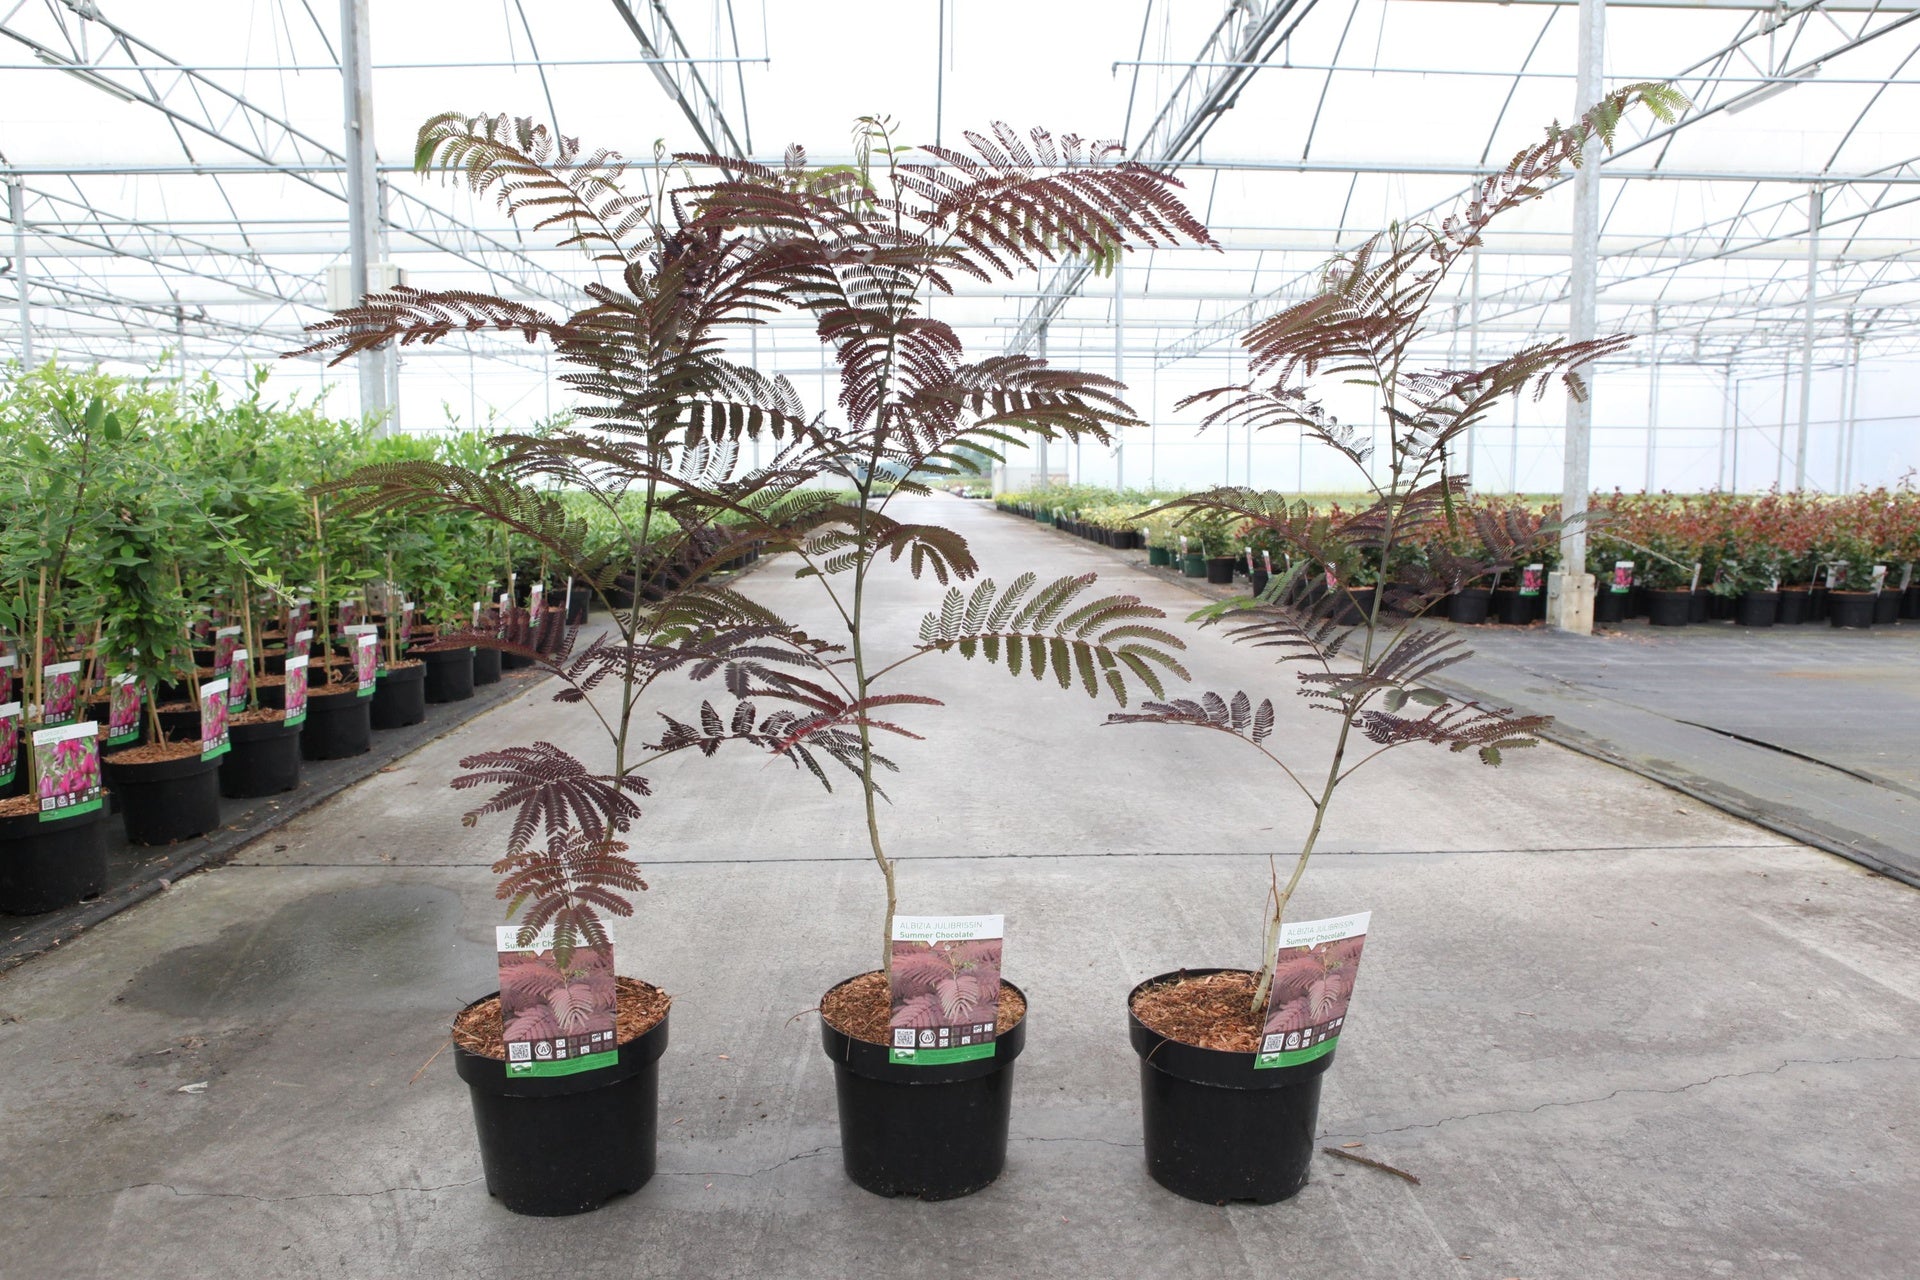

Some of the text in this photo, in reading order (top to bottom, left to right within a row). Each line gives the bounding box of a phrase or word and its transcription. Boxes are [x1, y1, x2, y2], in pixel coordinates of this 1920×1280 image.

[899, 921, 983, 930] ALBIZIA JULIBRISSIN
[899, 931, 974, 939] Summer Chocolate
[1286, 931, 1346, 945] Summer Chocolate
